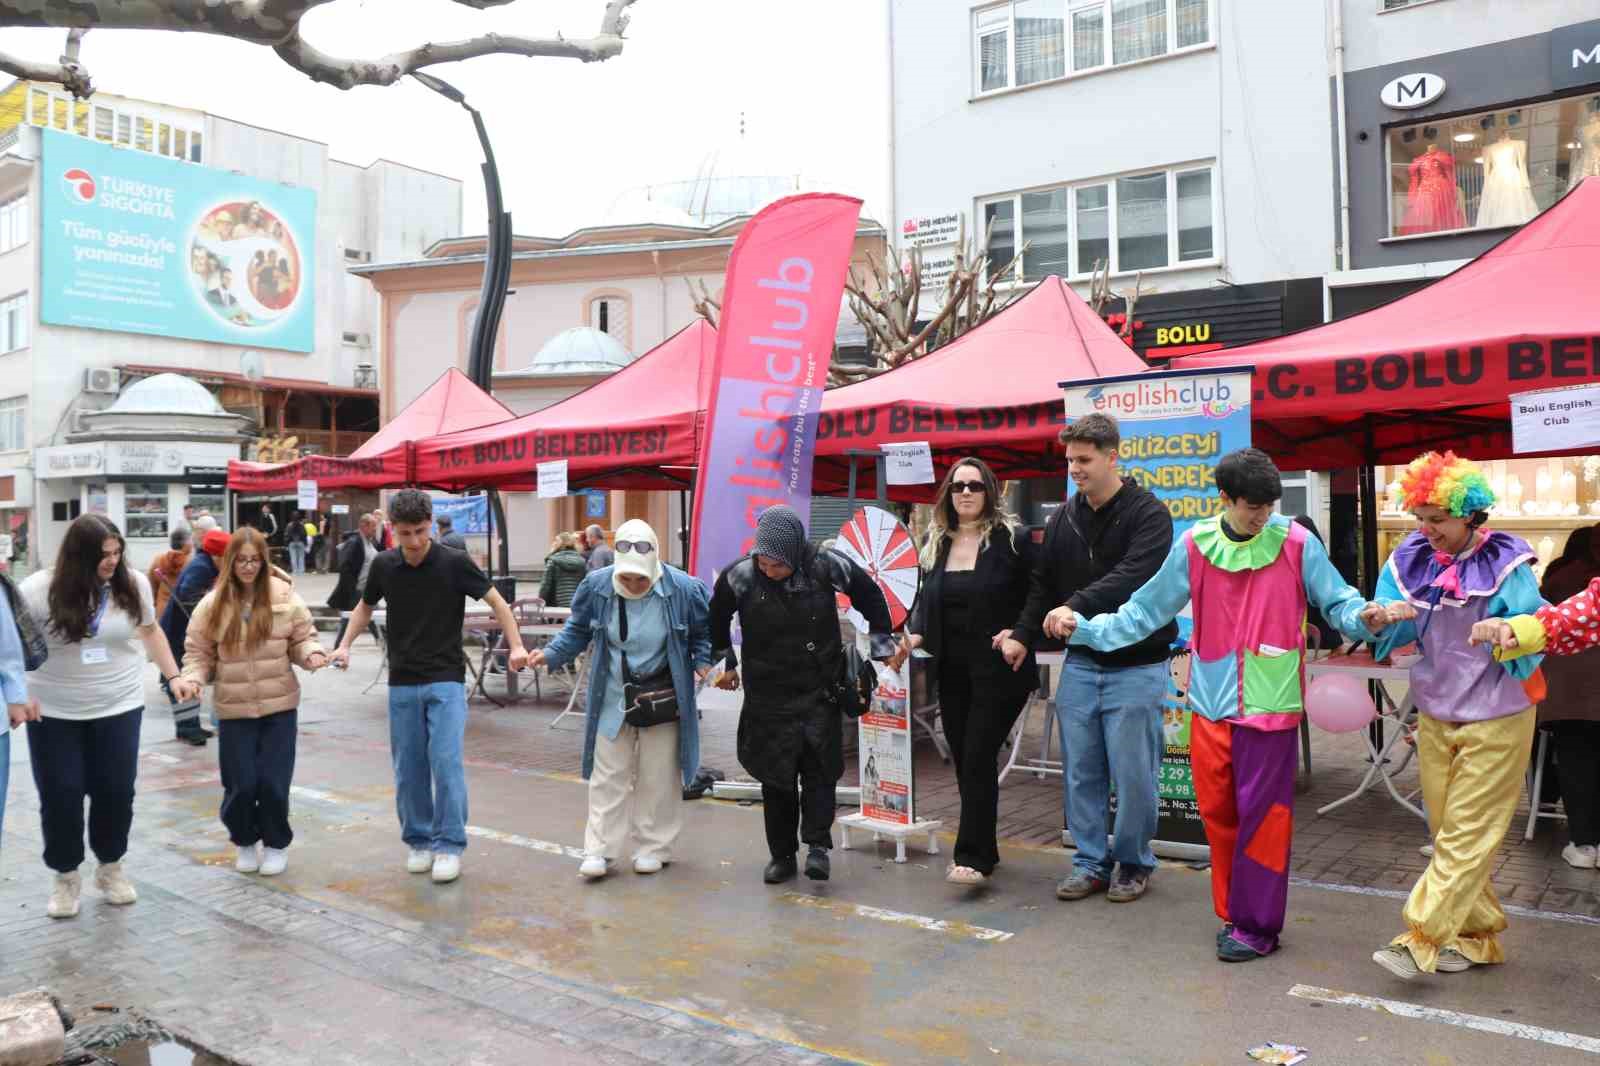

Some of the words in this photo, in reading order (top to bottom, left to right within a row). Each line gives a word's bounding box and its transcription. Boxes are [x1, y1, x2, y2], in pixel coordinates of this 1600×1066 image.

[1397, 77, 1426, 103] M
[1156, 323, 1211, 345] BOLU
[1251, 363, 1316, 400] .C.
[1335, 346, 1484, 395] BOLU
[798, 387, 811, 410] the
[1093, 378, 1231, 413] englishclub
[1520, 404, 1545, 414] Bolu
[1548, 399, 1593, 413] English
[794, 411, 807, 433] but
[1543, 415, 1570, 426] Club
[473, 436, 527, 464] BOLU
[791, 436, 804, 464] easy
[1168, 768, 1185, 780] 29
[1172, 800, 1188, 809] No:
